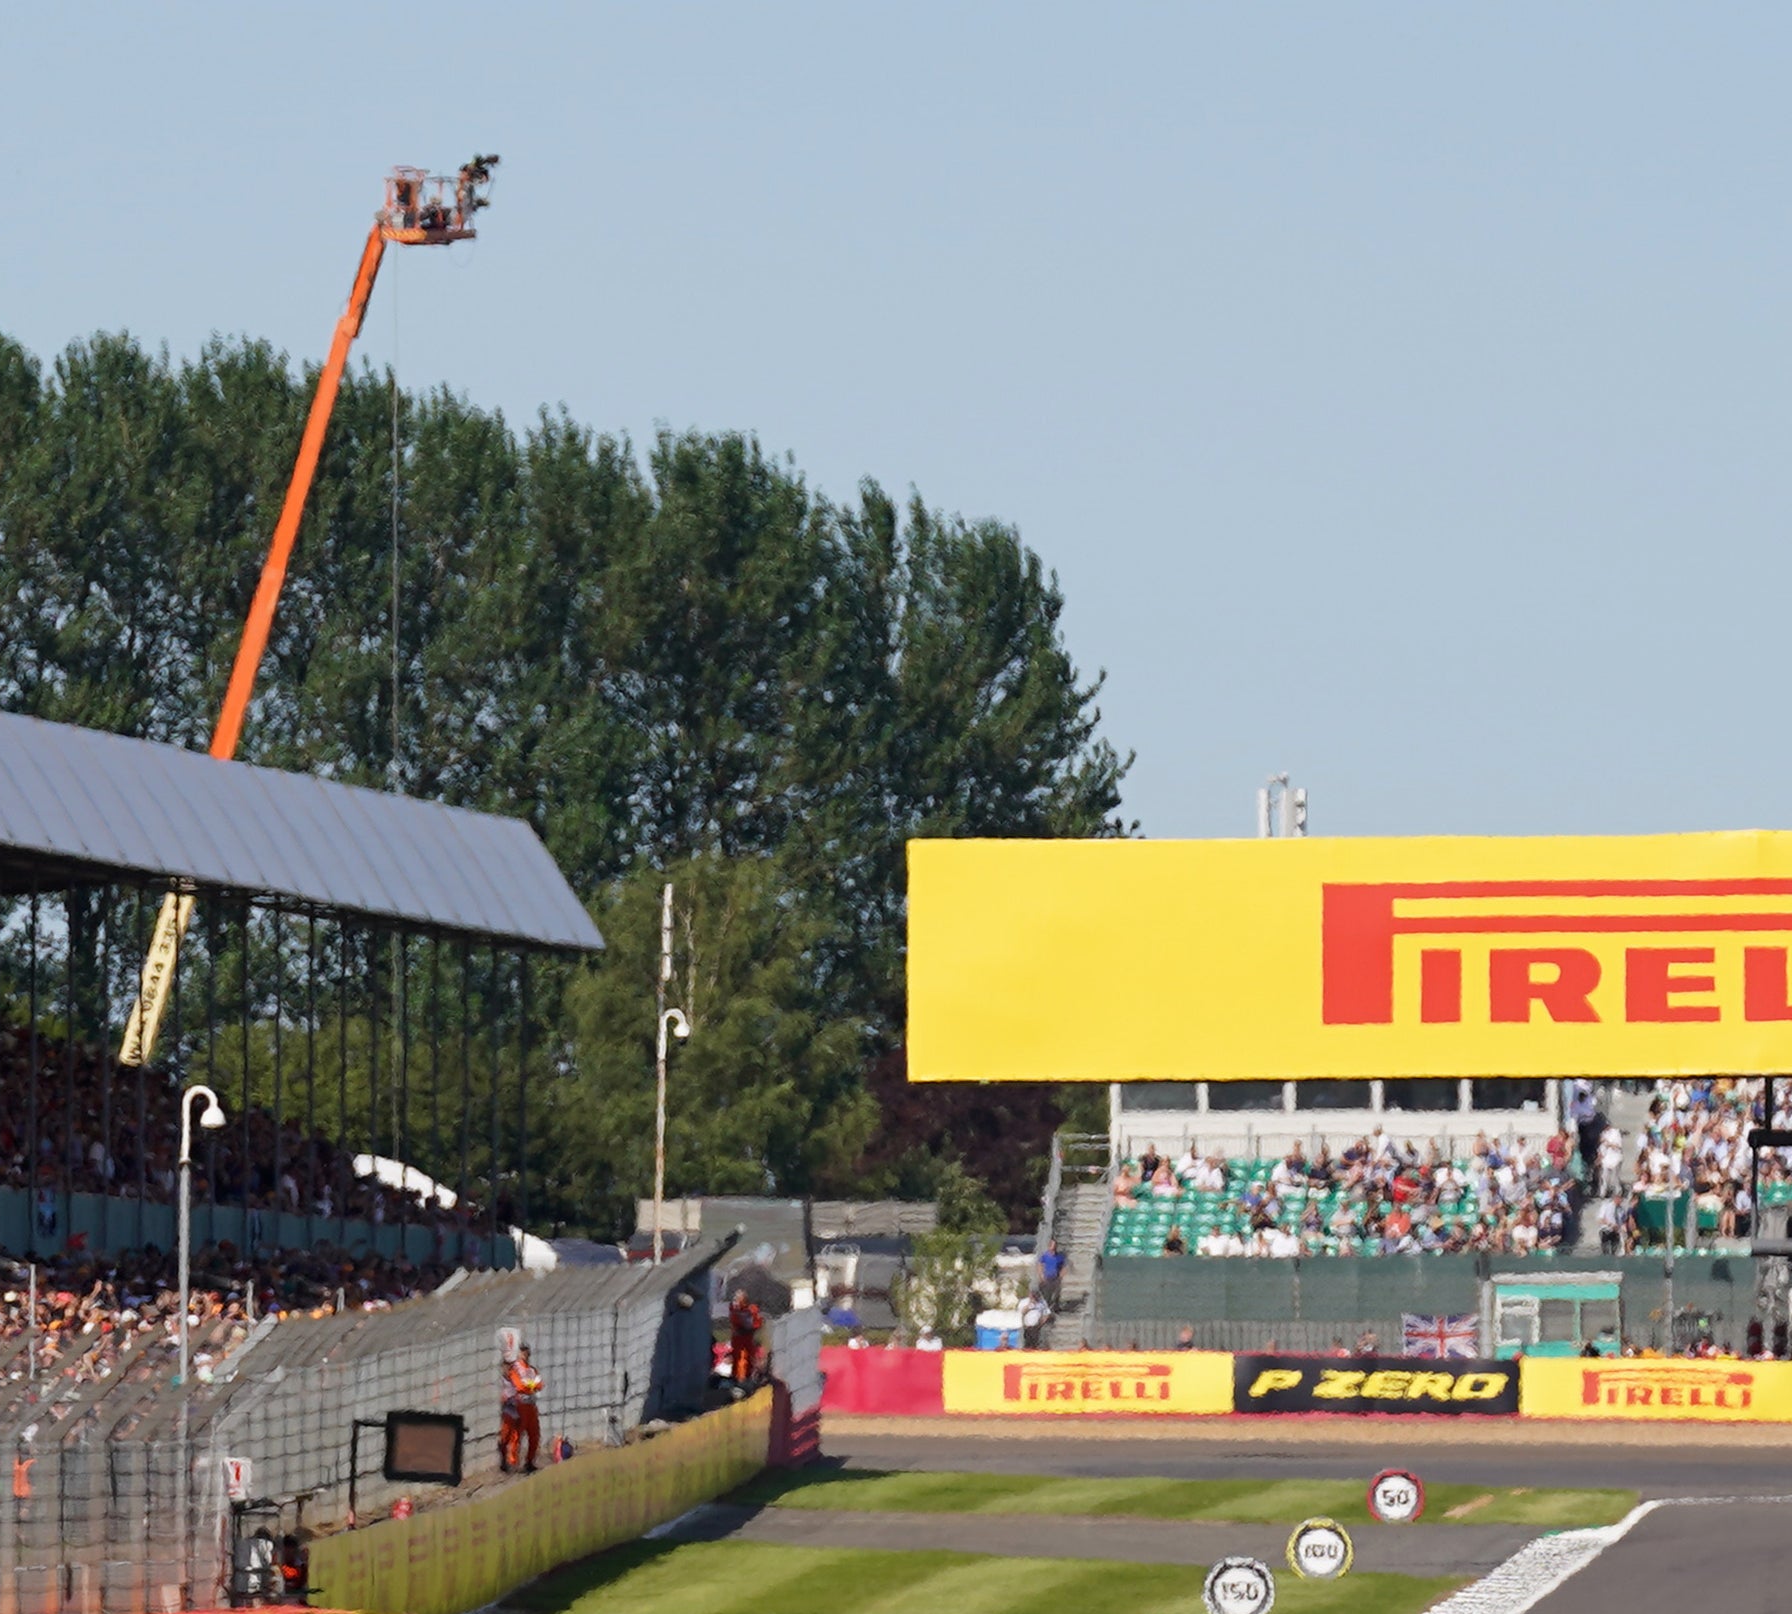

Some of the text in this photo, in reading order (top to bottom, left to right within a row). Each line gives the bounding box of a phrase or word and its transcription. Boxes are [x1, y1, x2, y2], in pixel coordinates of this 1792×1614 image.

[1003, 1363, 1172, 1401] PIRELLI
[1249, 1370, 1509, 1401] P ZERO
[1582, 1367, 1754, 1408] PIRELLI
[1382, 1489, 1409, 1507] 50
